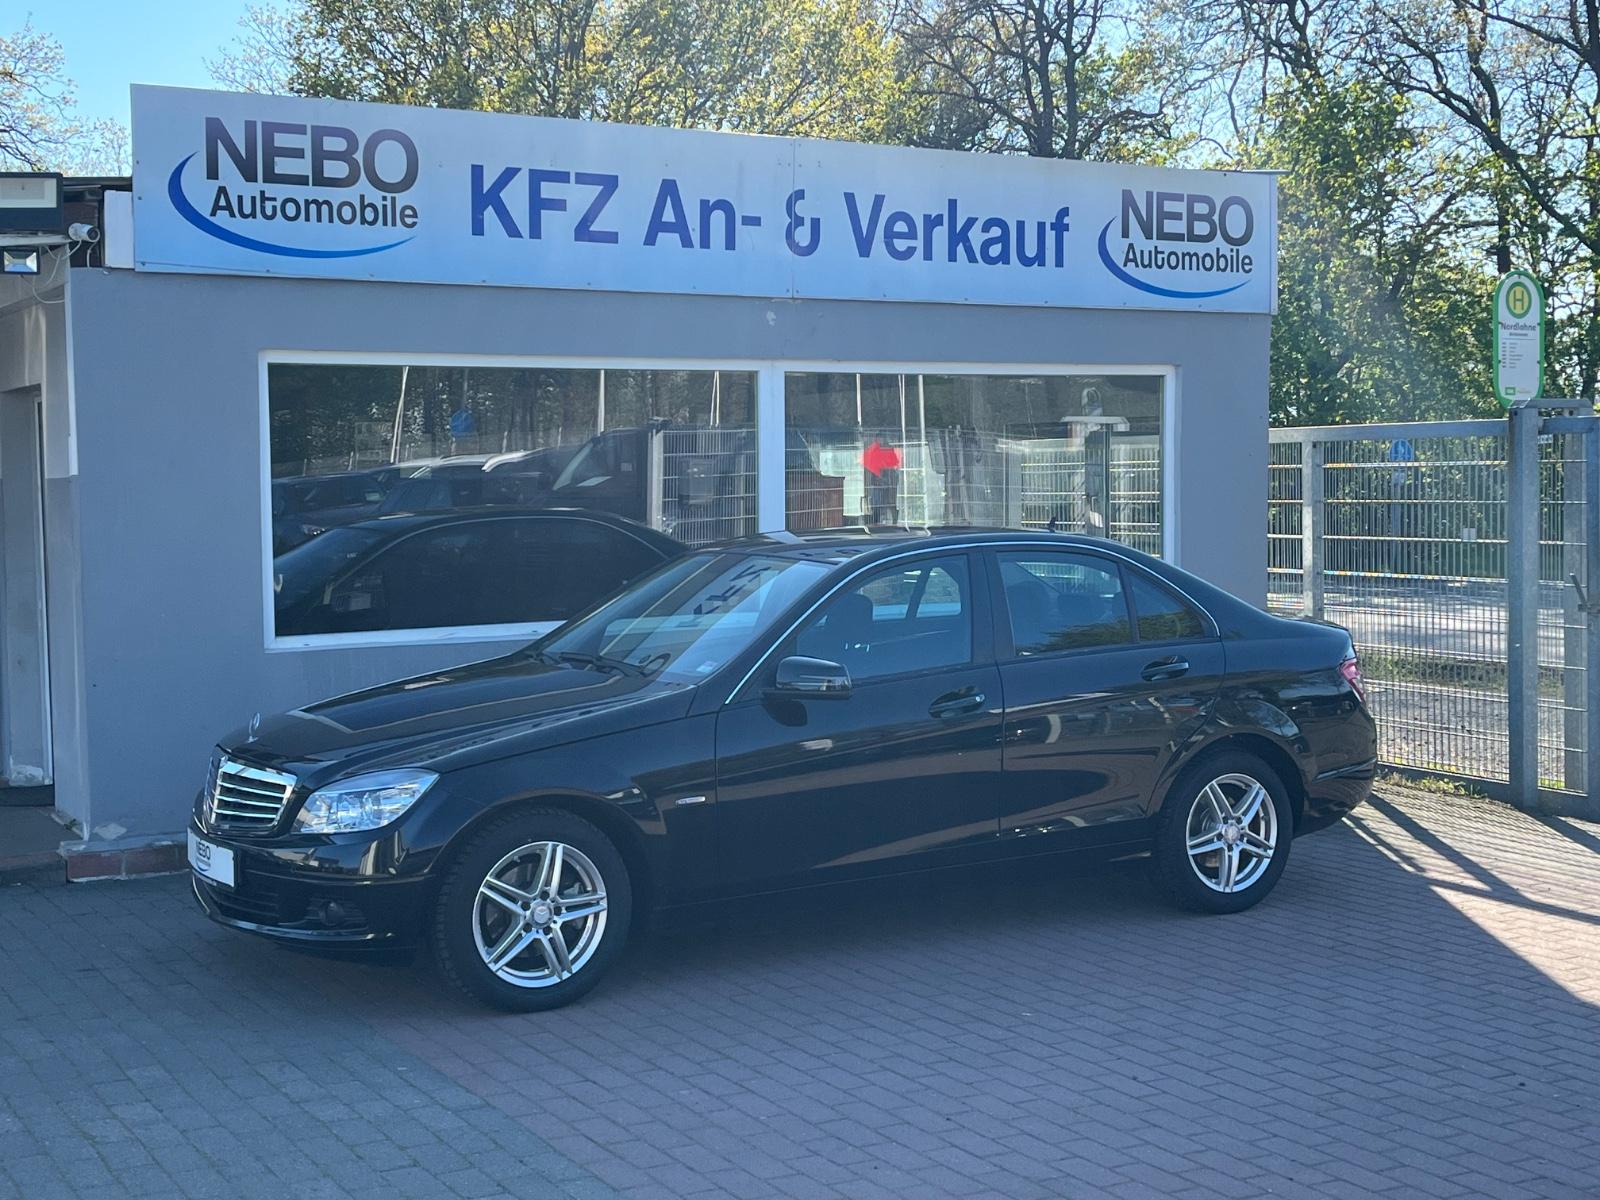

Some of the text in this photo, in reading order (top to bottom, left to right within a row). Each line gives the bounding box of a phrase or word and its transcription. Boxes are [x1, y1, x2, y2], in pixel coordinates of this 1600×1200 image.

[205, 116, 419, 194] NEBO
[209, 185, 419, 229] Automobile
[470, 164, 1070, 269] KFZ An- & Verkauf
[1121, 189, 1254, 247] NEBO
[1122, 242, 1253, 274] Automobile
[1513, 289, 1525, 311] H
